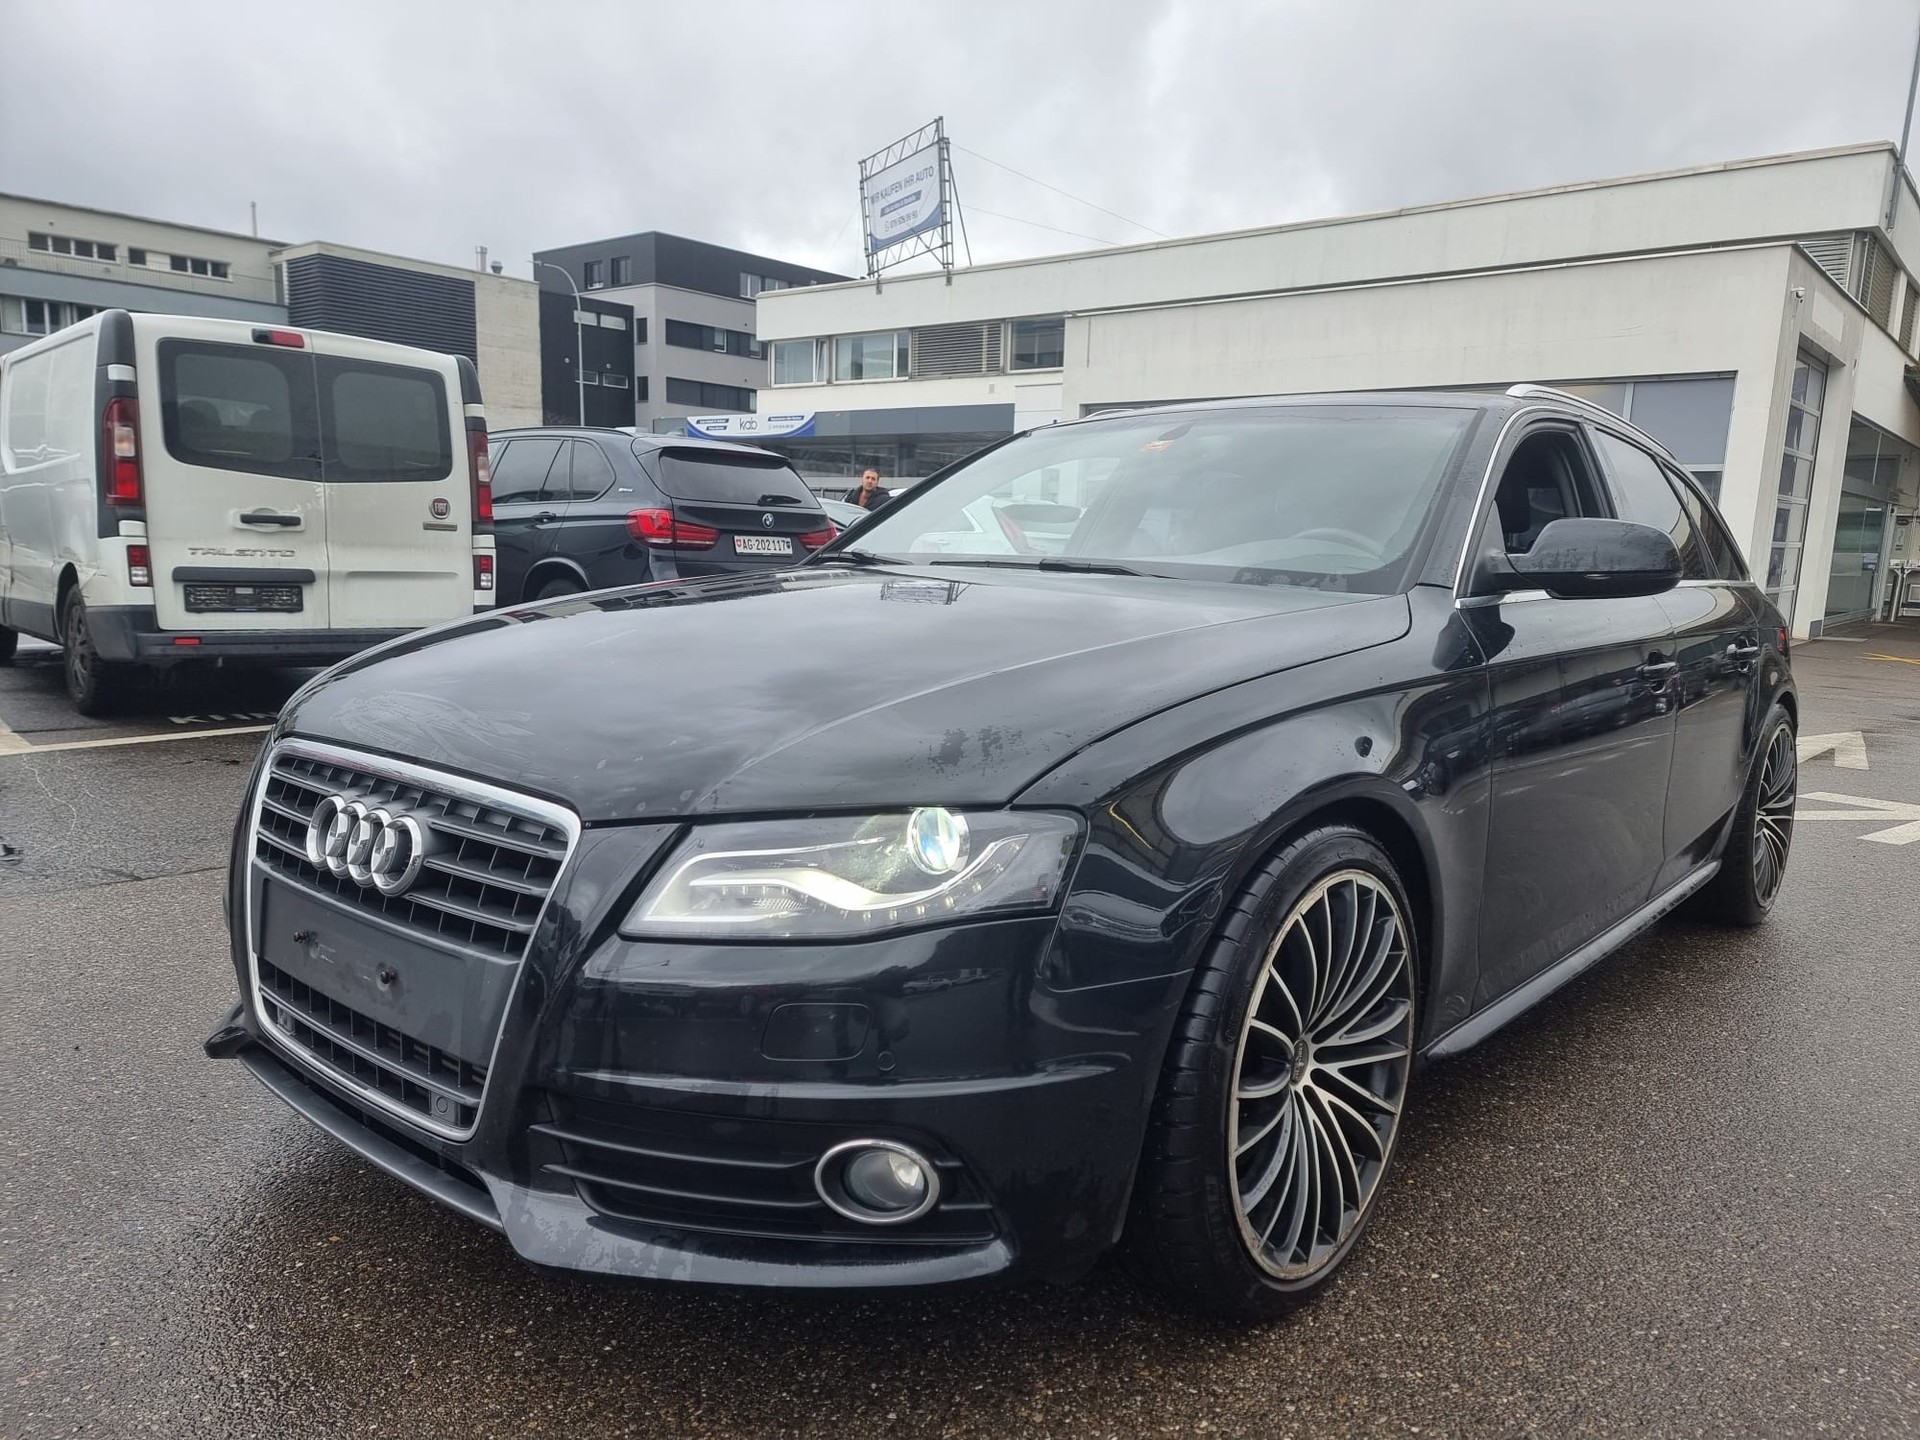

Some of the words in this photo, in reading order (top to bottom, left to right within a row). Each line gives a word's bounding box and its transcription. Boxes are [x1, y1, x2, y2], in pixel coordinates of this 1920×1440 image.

[880, 180, 903, 199] KAUFEN
[915, 165, 934, 182] AUTO
[739, 417, 758, 431] kab
[187, 547, 295, 557] TALENTO
